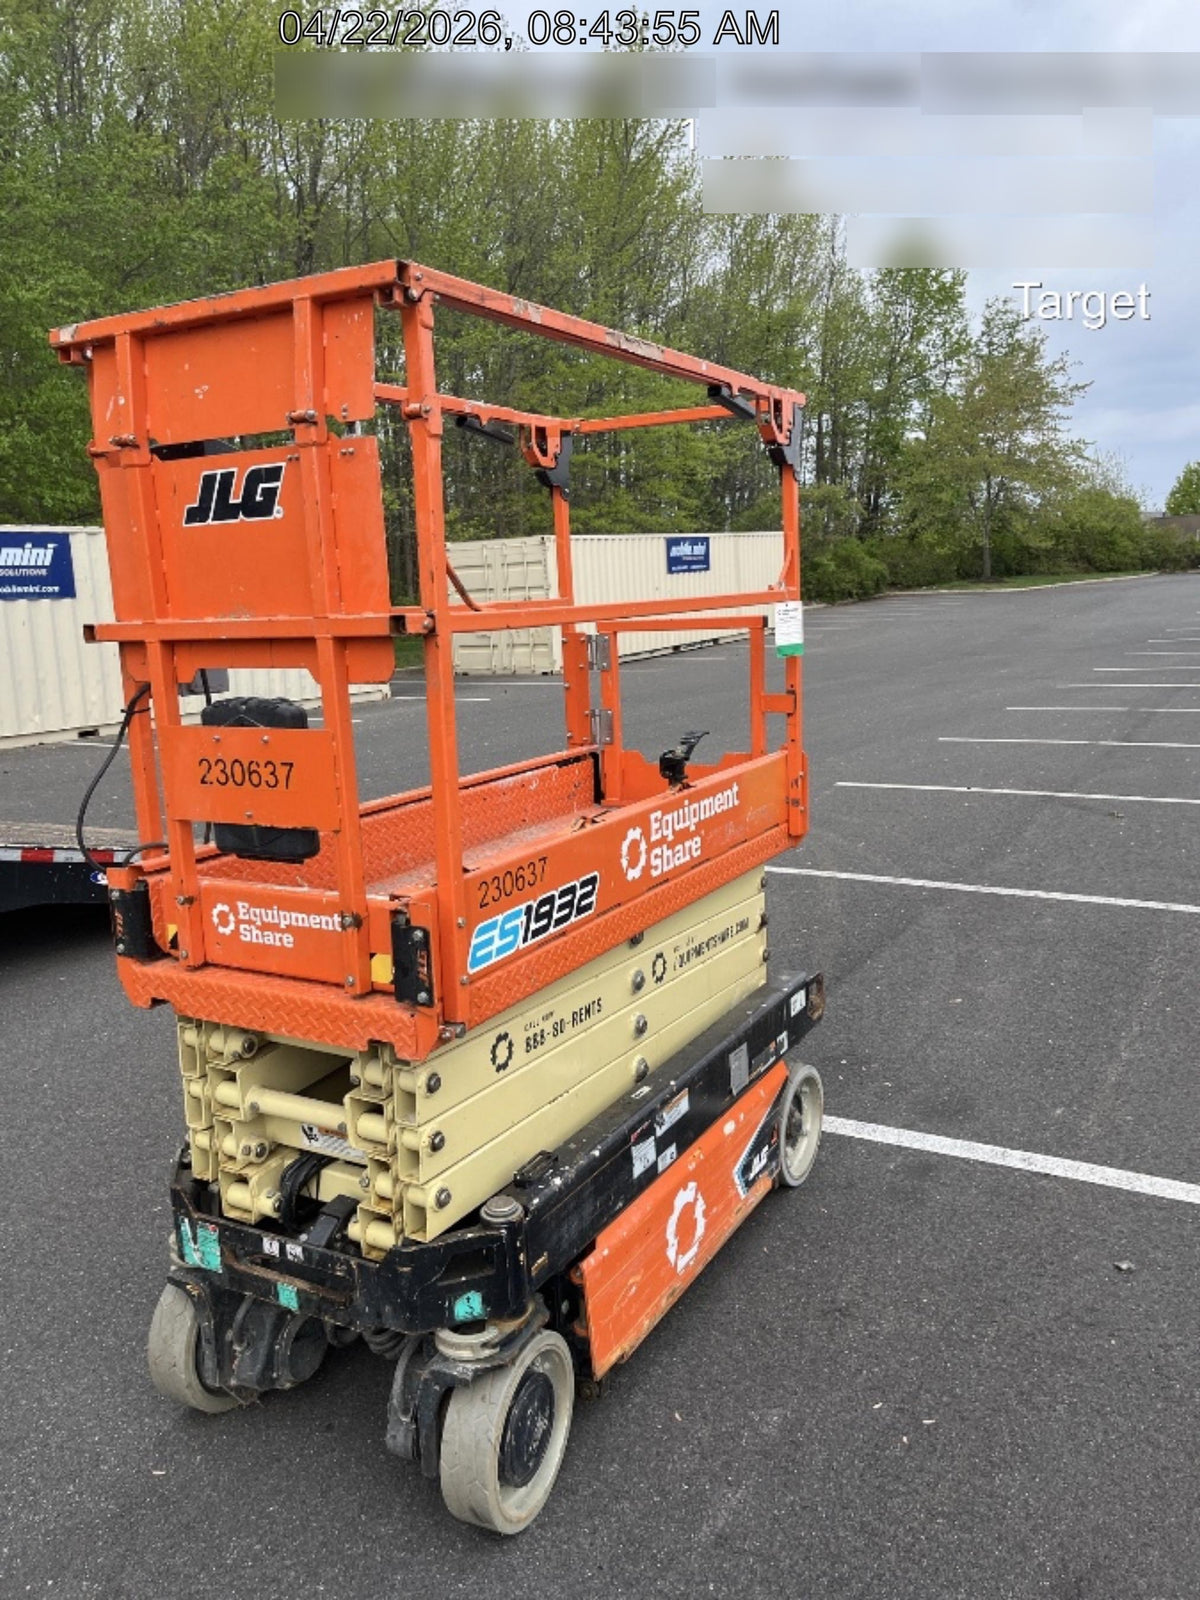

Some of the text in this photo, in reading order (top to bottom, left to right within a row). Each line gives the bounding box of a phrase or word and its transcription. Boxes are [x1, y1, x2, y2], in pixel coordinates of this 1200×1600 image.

[183, 462, 286, 527] JLG
[198, 758, 295, 790] 230637
[649, 781, 740, 843] Equipment
[649, 835, 702, 878] Share
[478, 856, 548, 909] 230637
[236, 901, 342, 932] Equipment
[239, 924, 294, 948] Share
[468, 870, 600, 974] ES1932
